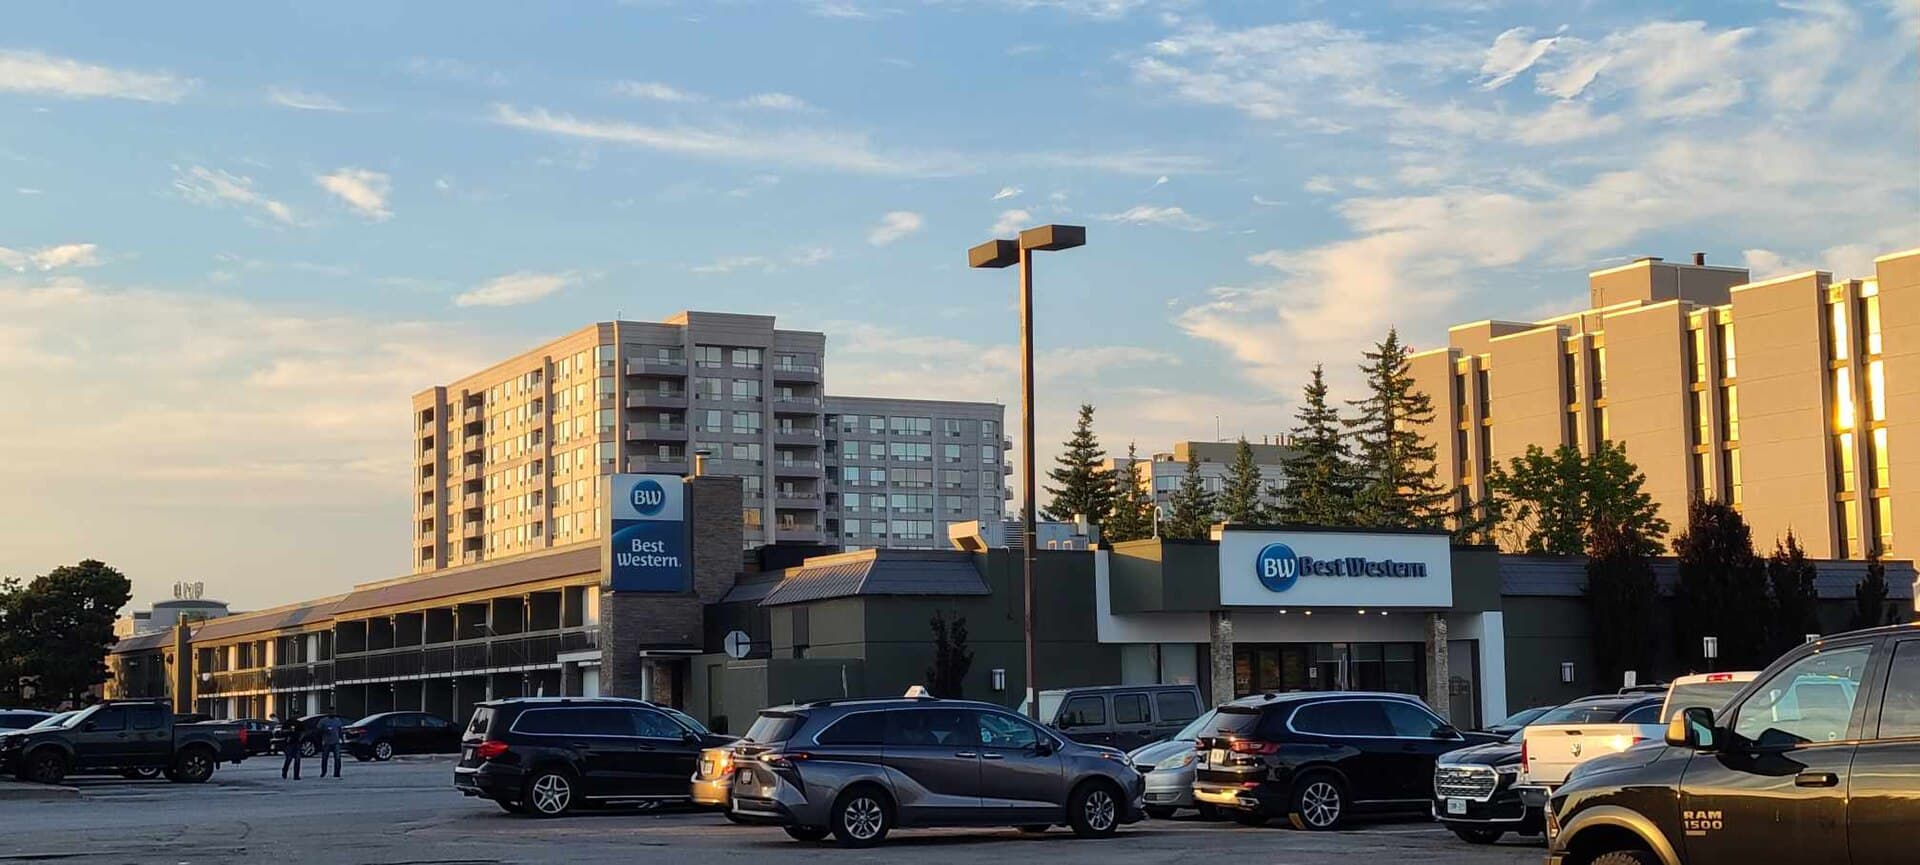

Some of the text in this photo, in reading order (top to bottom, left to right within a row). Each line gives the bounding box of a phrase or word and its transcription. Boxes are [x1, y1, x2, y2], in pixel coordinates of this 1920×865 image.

[634, 490, 661, 505] BW
[632, 539, 664, 553] Best
[1264, 557, 1427, 577] BW Best Western
[1683, 811, 1723, 820] RAM
[1683, 820, 1723, 830] 1500
